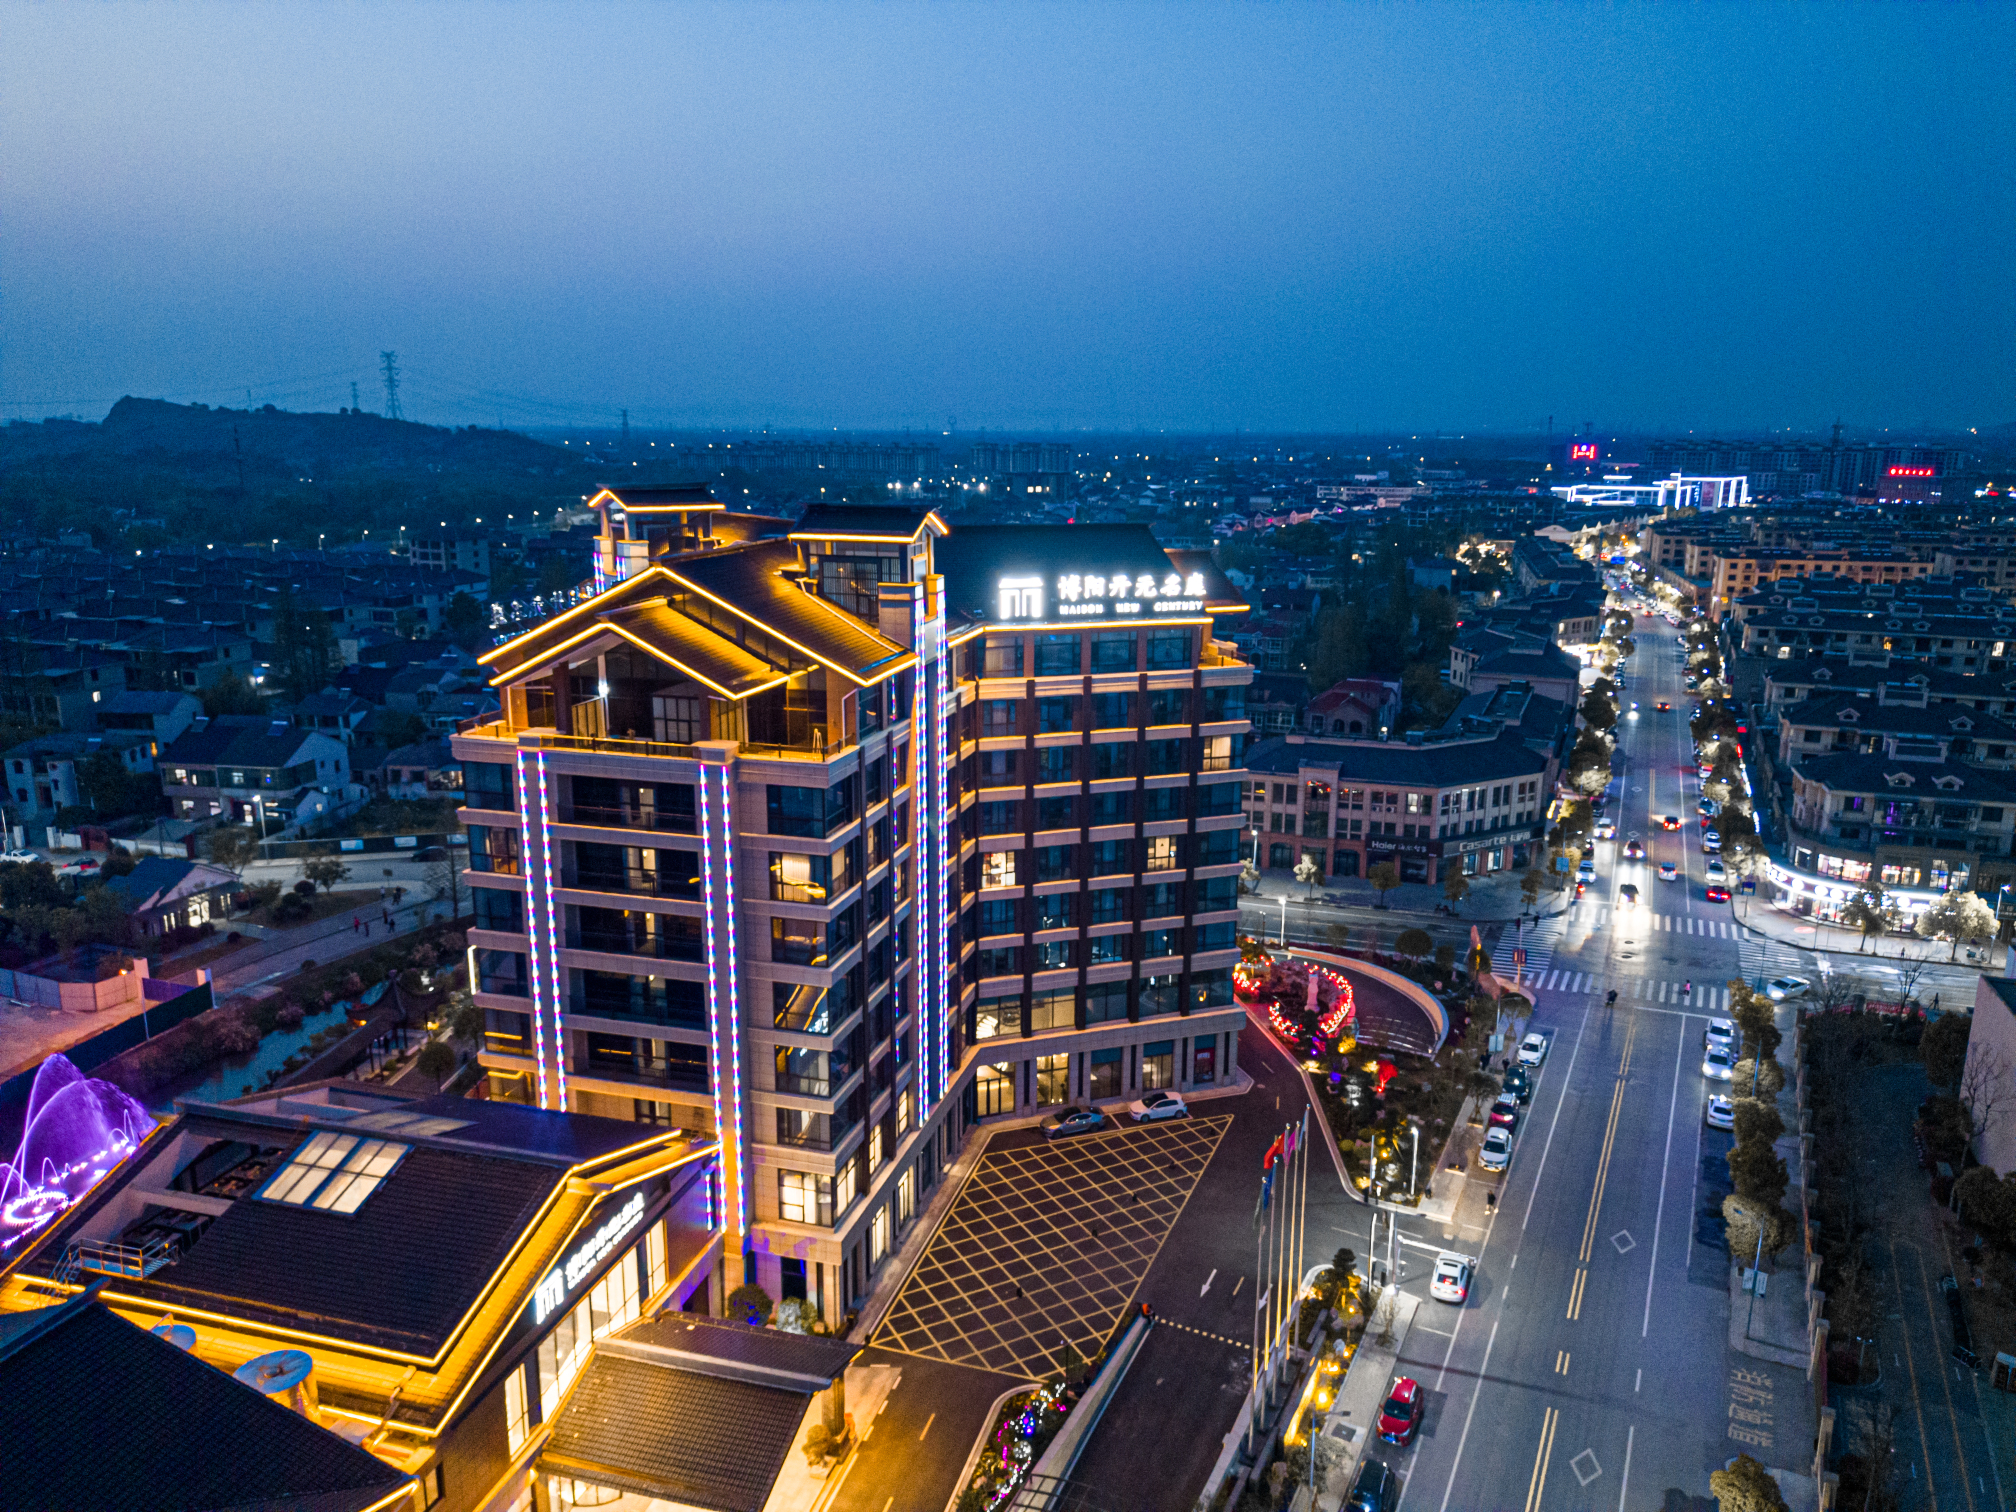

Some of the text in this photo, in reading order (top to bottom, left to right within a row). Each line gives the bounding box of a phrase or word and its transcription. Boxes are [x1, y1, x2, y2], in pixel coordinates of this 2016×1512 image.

[1060, 601, 1203, 615] MAISON NEW CENTURY
[1371, 840, 1397, 850] Haier
[1459, 835, 1507, 852] Casarte
